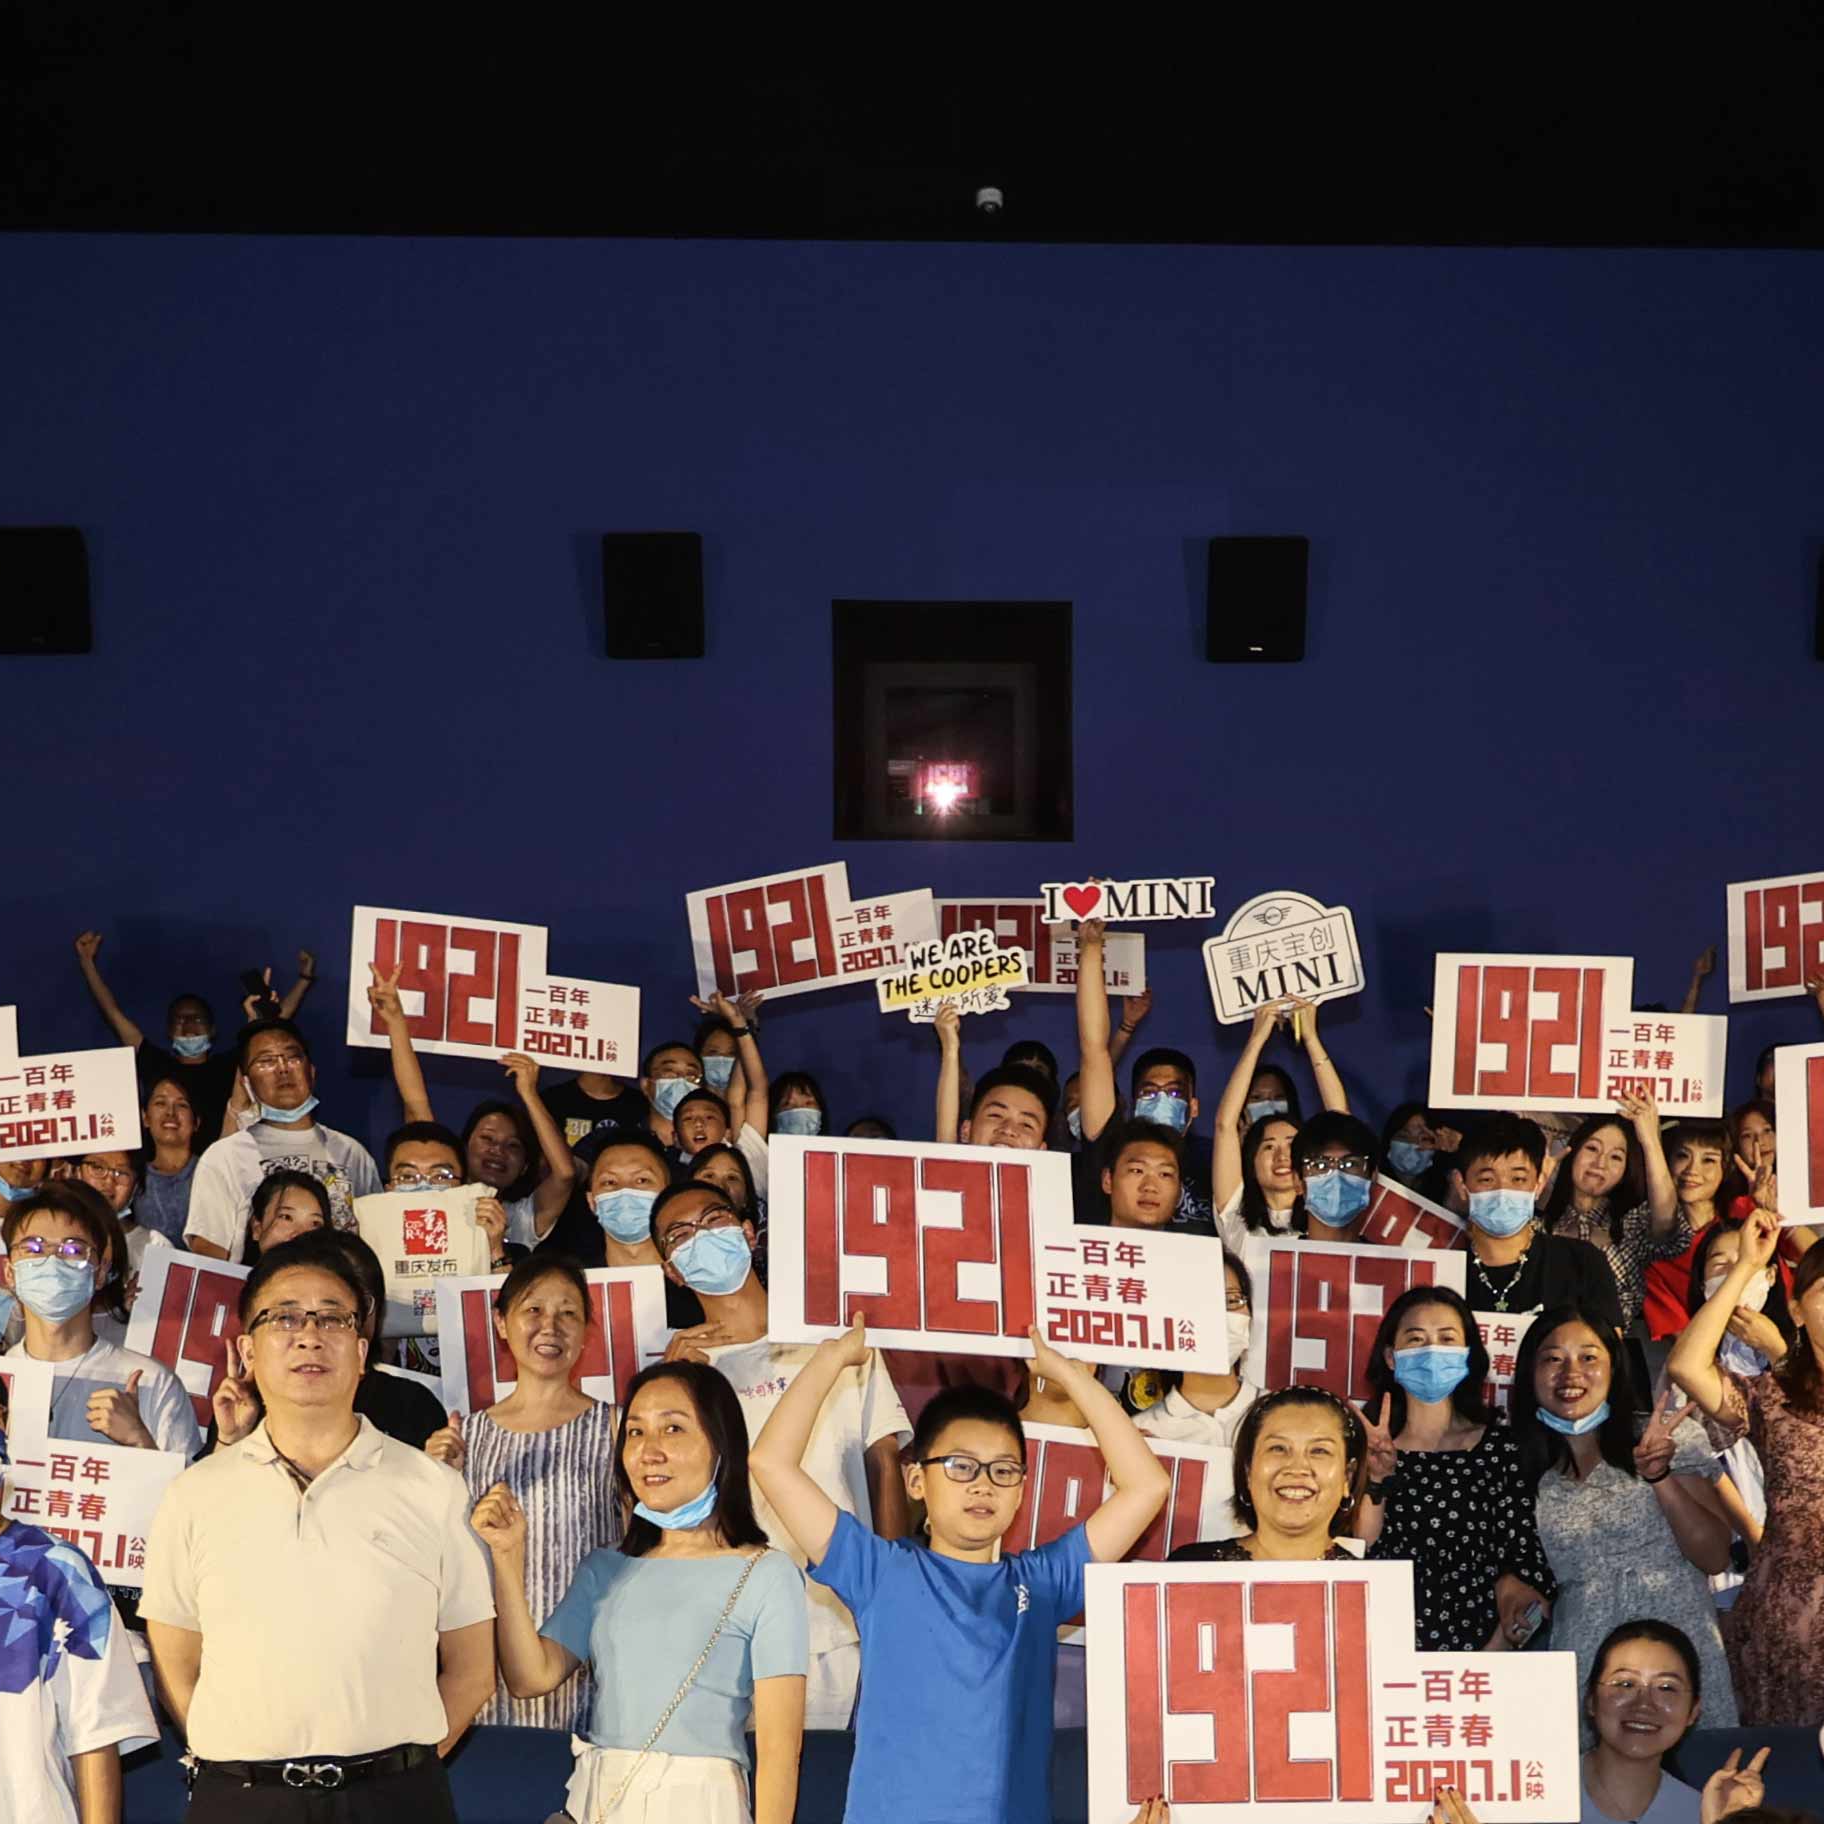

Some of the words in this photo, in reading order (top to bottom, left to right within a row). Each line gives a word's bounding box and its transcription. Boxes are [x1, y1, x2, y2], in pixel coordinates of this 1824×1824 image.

[836, 904, 891, 925] 一百年
[1044, 887, 1060, 920] I
[1104, 881, 1211, 918] MINI
[706, 873, 837, 997] 1921
[839, 925, 894, 948] 正青春
[911, 945, 941, 970] WE
[949, 934, 992, 960] ARE
[1227, 923, 1335, 973] 重庆宝创
[370, 918, 521, 1049] 1921
[882, 973, 922, 999] THE
[929, 952, 1021, 989] COOPERS
[1233, 952, 1343, 1008] MINI
[526, 985, 590, 1006] 一百年
[526, 1007, 590, 1030] 正青春
[1453, 965, 1606, 1098] 1921
[1609, 1023, 1675, 1044] 一百年
[524, 1029, 604, 1061] 2021.7.1
[1608, 1049, 1675, 1071] 正青春
[0, 1114, 98, 1149] 2021.7.1
[804, 1150, 1037, 1337] 1921
[1044, 1240, 1146, 1268] 一百年
[395, 1259, 457, 1274] 重庆发布
[1046, 1273, 1148, 1304] 正青春
[1047, 1307, 1175, 1351] 2021.7.1
[15, 1454, 110, 1484] 一百年
[10, 1486, 107, 1522] 正青春
[1123, 1580, 1374, 1803] 1921
[1383, 1670, 1492, 1702] 一百年
[1384, 1715, 1493, 1748] 正青春
